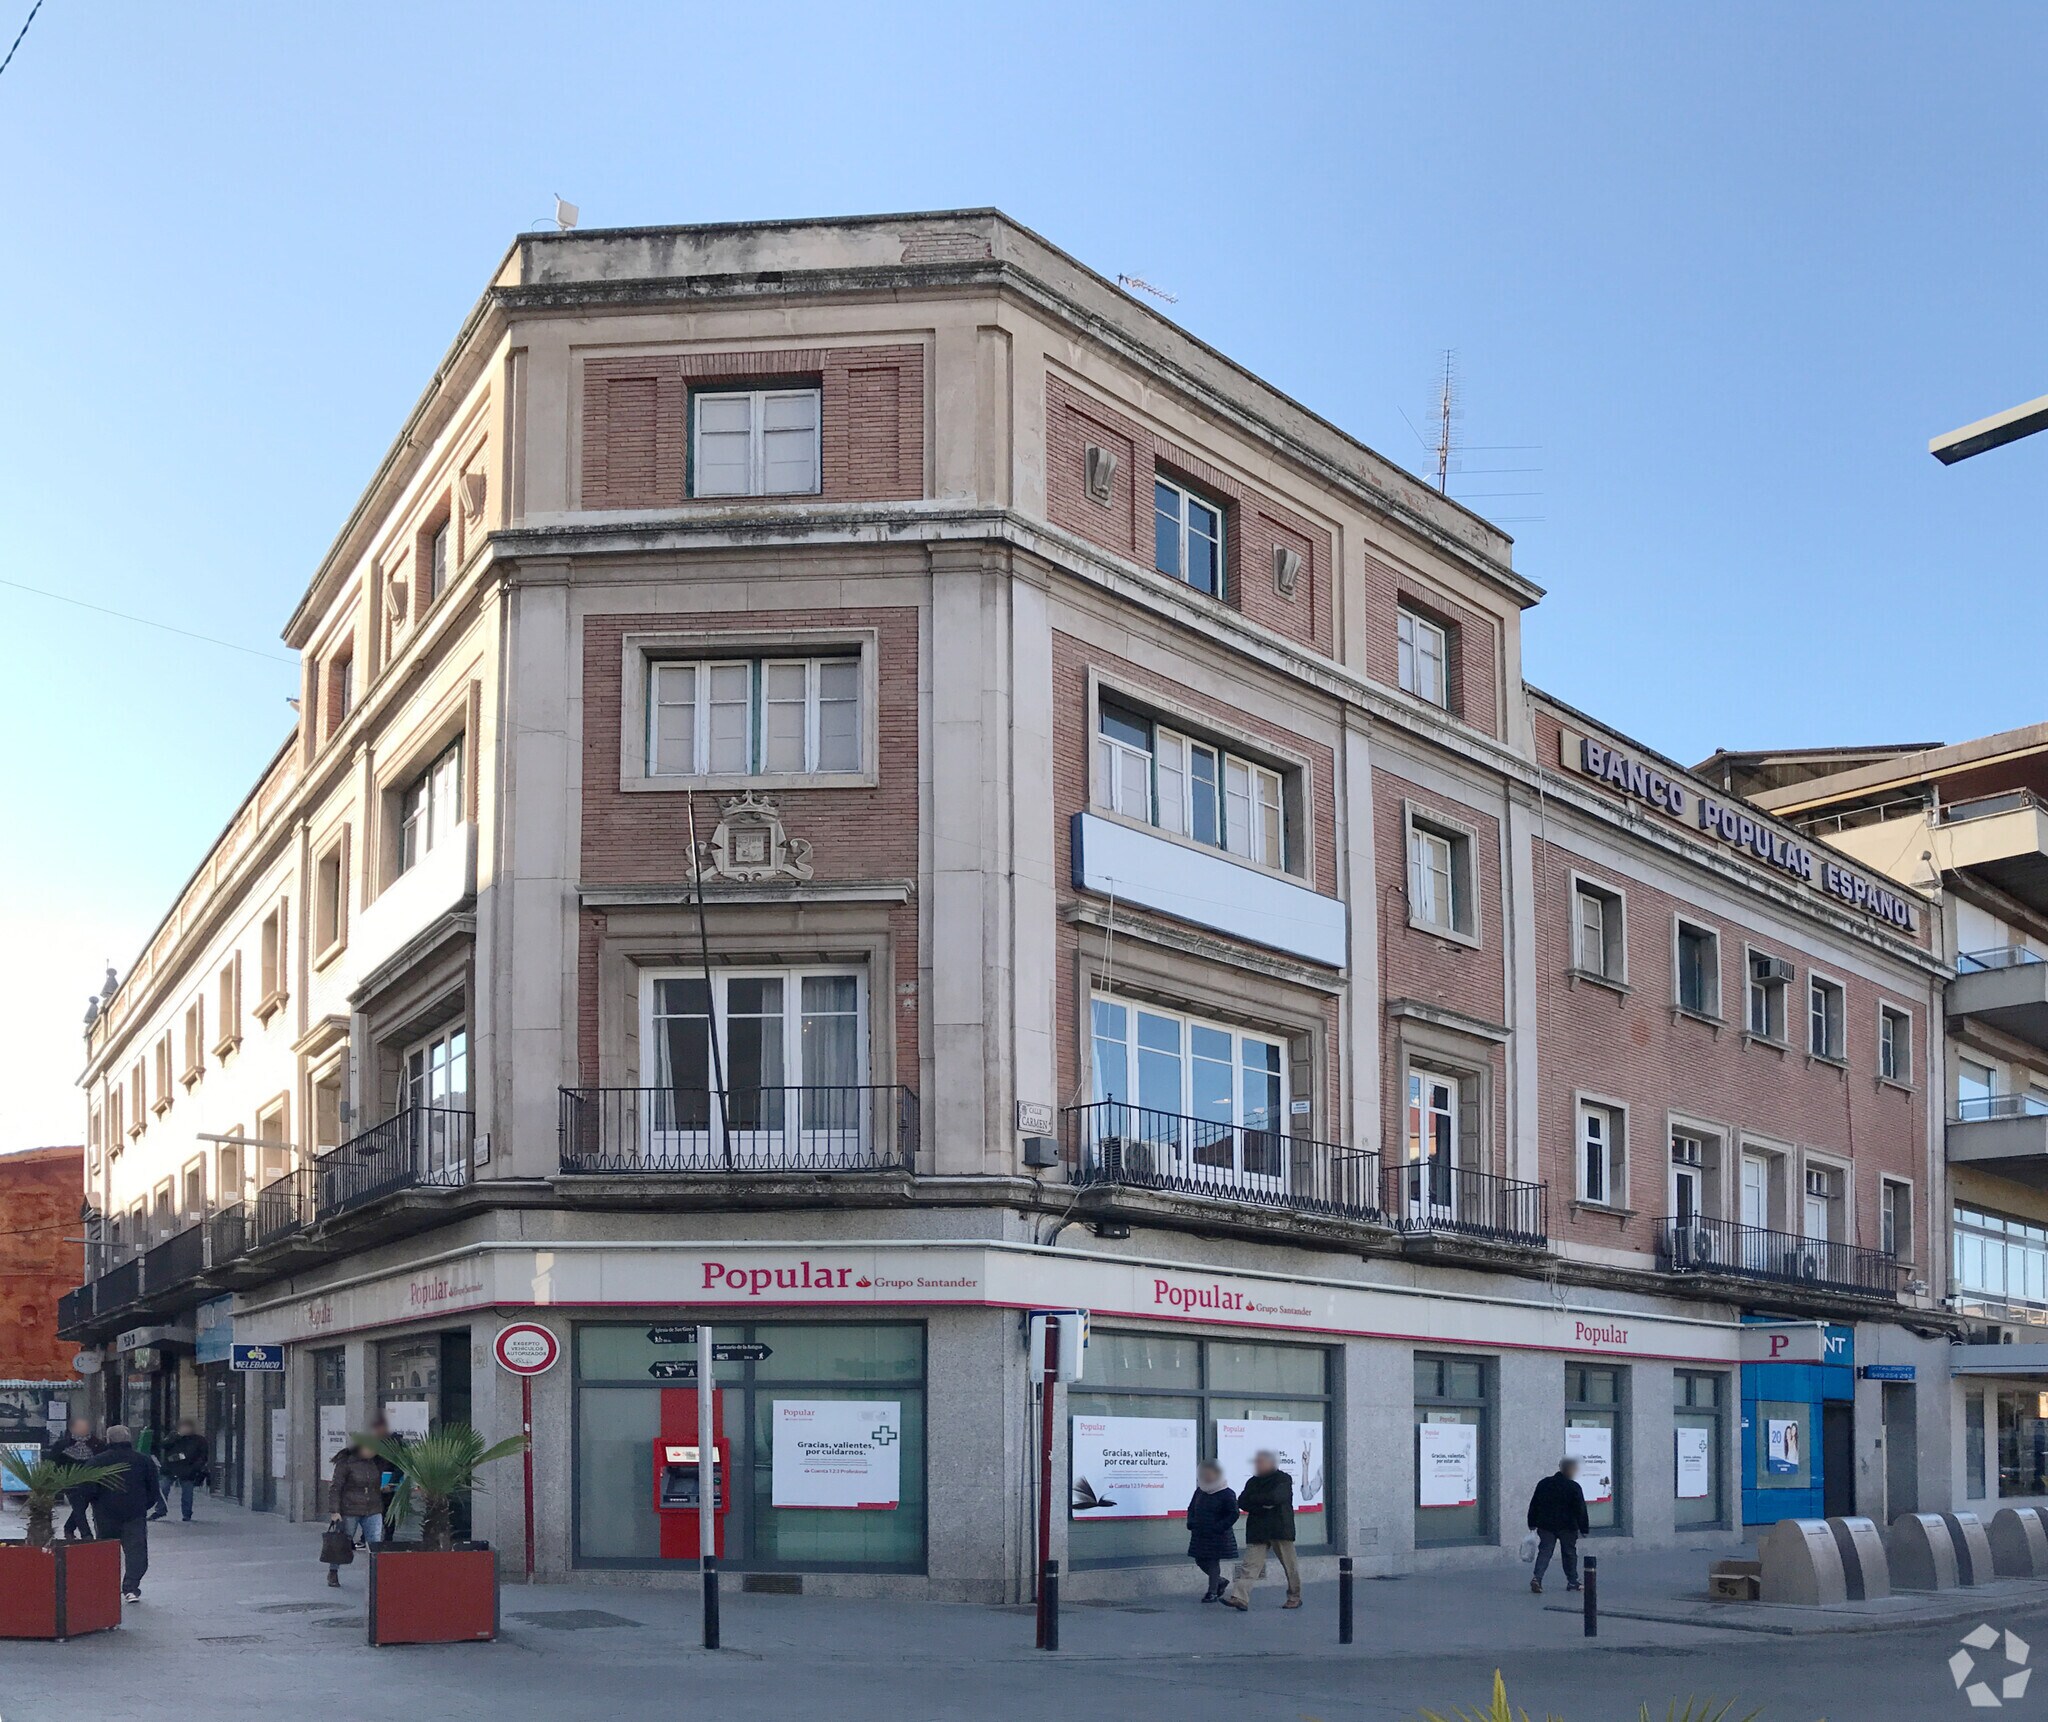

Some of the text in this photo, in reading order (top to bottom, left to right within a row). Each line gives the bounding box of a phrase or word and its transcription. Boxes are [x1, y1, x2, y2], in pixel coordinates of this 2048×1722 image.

[1582, 738, 1687, 815] BANCO
[1700, 798, 1813, 880] POPULAR
[1022, 1116, 1048, 1130] CARMEN
[701, 1261, 978, 1296] Popular Grupo Santander
[410, 1277, 449, 1309] Popular
[1153, 1279, 1312, 1317] Popular Grupo Santander
[1575, 1321, 1629, 1346] Popular
[1768, 1335, 1790, 1357] P
[783, 1409, 815, 1417] Popular
[1080, 1422, 1106, 1431] Popular
[1223, 1425, 1246, 1433] Popular
[1771, 1430, 1782, 1444] 20
[797, 1441, 875, 1450] Gracias, valientes,
[1102, 1449, 1170, 1459] Gracias, valientes,
[1104, 1459, 1118, 1467] por
[1139, 1458, 1168, 1466] cultura.
